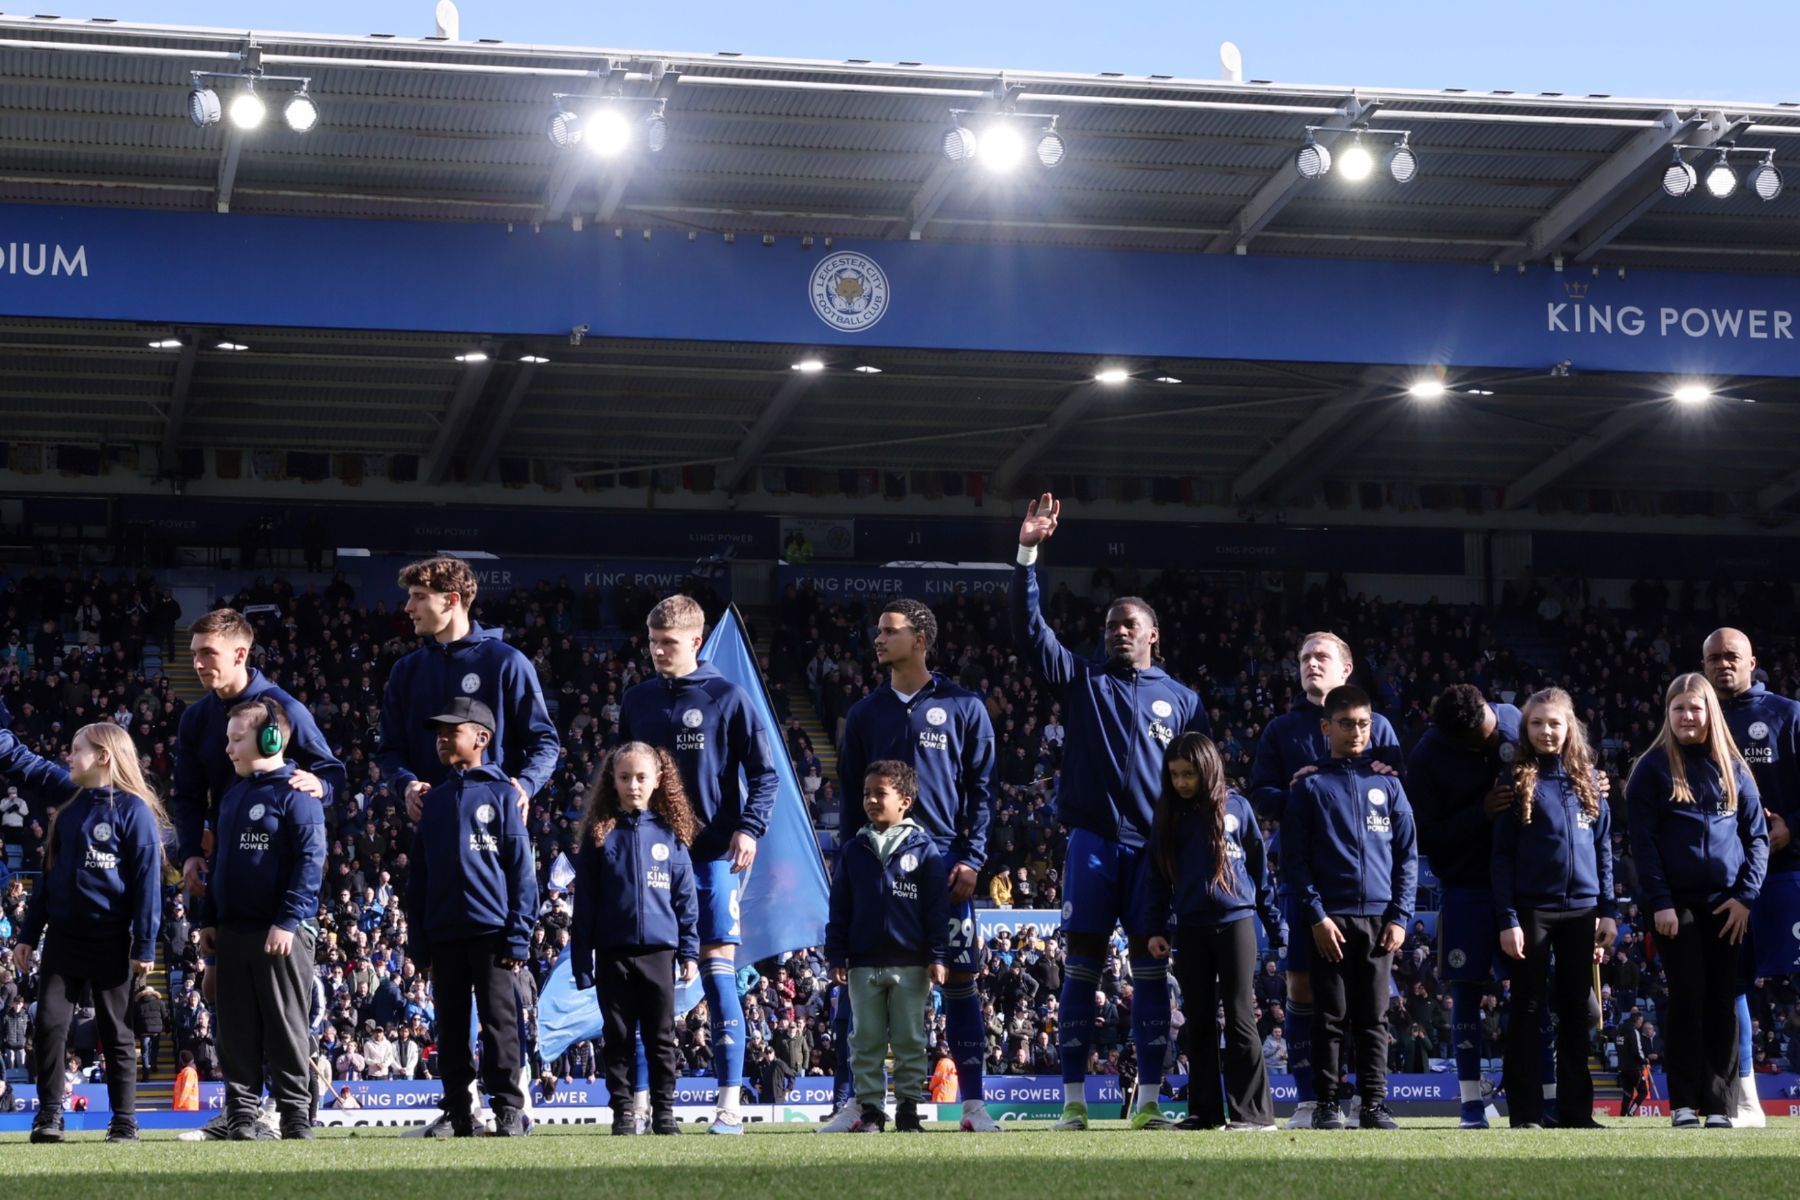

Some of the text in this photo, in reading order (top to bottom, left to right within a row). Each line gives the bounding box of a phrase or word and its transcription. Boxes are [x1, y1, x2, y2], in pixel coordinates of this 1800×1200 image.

[816, 257, 883, 291] LEICESTER CITY
[816, 292, 883, 326] FOOTBALL CLUB
[1547, 302, 1795, 340] KING POWER
[689, 533, 753, 545] KING POWER
[1109, 543, 1124, 555] H1
[475, 570, 512, 584] WER
[795, 577, 904, 592] KNG POWER
[973, 581, 1010, 593] POW
[1149, 722, 1174, 739] KING
[676, 733, 705, 743] KING
[919, 731, 947, 744] KING
[677, 742, 705, 751] POWER
[919, 740, 947, 751] POWER
[1744, 747, 1773, 757] KING
[1745, 756, 1773, 764] POWER
[1366, 815, 1390, 826] KING
[1367, 824, 1390, 833] POWER
[239, 833, 270, 844] KING
[469, 833, 498, 845] KING
[239, 842, 269, 851] POWER
[86, 850, 116, 862] KING
[84, 860, 116, 869] POWER
[892, 881, 918, 893] KING
[892, 890, 918, 901] POWER
[948, 918, 975, 948] 29
[806, 1090, 835, 1102] POW
[984, 1089, 1061, 1101] NG POWER
[1098, 1087, 1122, 1100] KIN
[1270, 1086, 1298, 1098] POW
[1393, 1085, 1442, 1098] POWER
[396, 1093, 444, 1106] POWE
[1639, 1105, 1661, 1117] BIA
